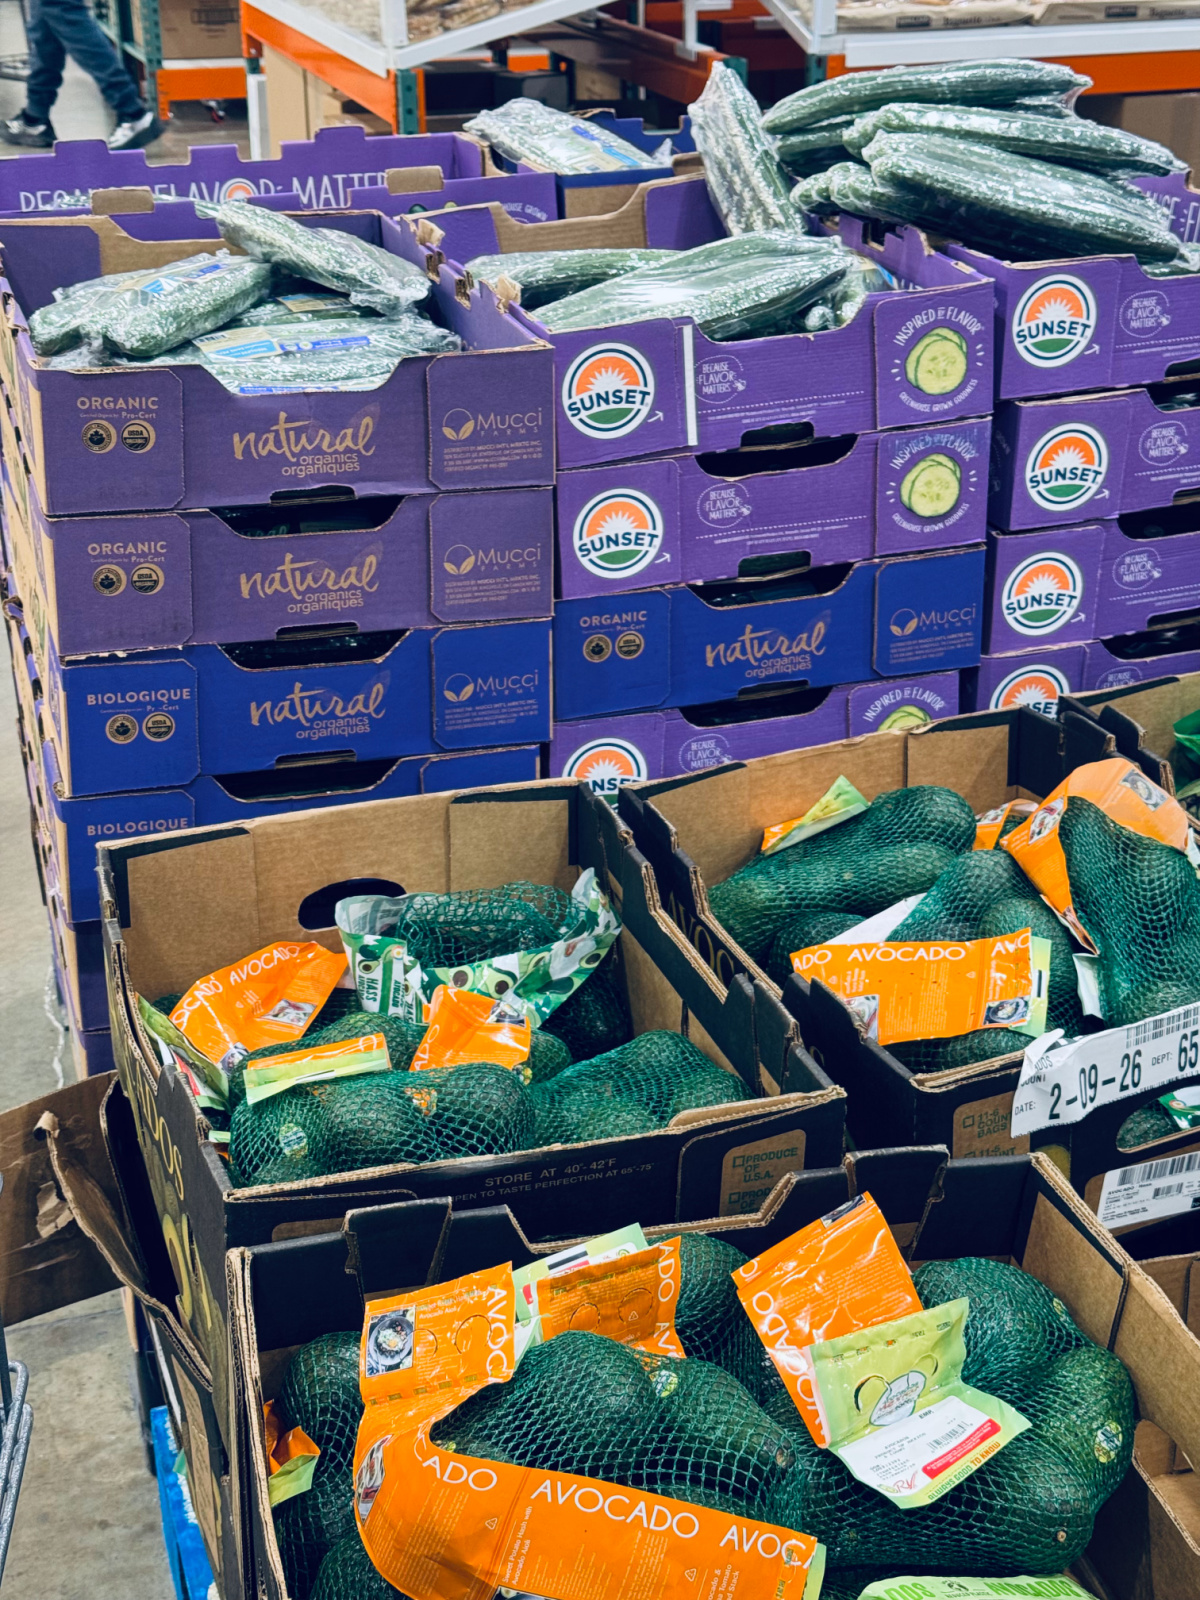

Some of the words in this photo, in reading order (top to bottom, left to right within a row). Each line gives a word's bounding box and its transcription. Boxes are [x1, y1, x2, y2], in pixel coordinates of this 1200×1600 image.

[1132, 297, 1157, 307] BECAUSE
[1127, 306, 1160, 319] FLAVOR
[893, 308, 936, 346] INSPIRED
[946, 306, 981, 335] FLAVOR
[1130, 317, 1157, 329] MATTERS
[1016, 320, 1091, 344] SUNSET
[702, 361, 729, 373] BECAUSE
[699, 371, 734, 385] FLAVOR
[702, 383, 731, 394] MATTERS
[899, 391, 931, 412] GREENHOUSE
[932, 401, 953, 412] GROWN
[953, 378, 978, 404] GOODNESS
[77, 397, 158, 409] ORGANIC
[567, 388, 651, 418] SUNSET
[122, 411, 156, 419] Pro-Cert
[233, 411, 376, 462] natural
[481, 427, 538, 437] FARMS
[1151, 427, 1176, 437] BECAUSE
[1147, 436, 1178, 449] FLAVOR
[300, 453, 358, 464] organics
[889, 435, 931, 470] INSPIRED
[941, 434, 976, 462] FLAVOR
[1149, 447, 1174, 457] MATTERS
[282, 462, 360, 477] organiques
[1029, 467, 1102, 489] SUNSET
[709, 488, 735, 500] BECAUSE
[705, 498, 740, 512] FLAVOR
[709, 509, 737, 520] MATTERS
[892, 512, 921, 533] GREENHOUSE
[923, 524, 943, 533] GROWN
[87, 541, 168, 555] ORGANIC
[578, 531, 659, 558] SUNSET
[131, 555, 165, 563] Pro-Cert
[481, 562, 537, 571] FARMS
[1124, 554, 1148, 564] BECAUSE
[1121, 562, 1152, 574] FLAVOR
[240, 553, 379, 599] natural
[1123, 571, 1148, 582] MATTERS
[305, 590, 361, 602] organics
[287, 599, 364, 614] organiques
[1005, 592, 1077, 616] SUNSET
[580, 611, 647, 627] ORGANIC
[705, 624, 826, 667] natural
[761, 654, 810, 667] organics
[745, 661, 811, 678] organiques
[87, 688, 191, 705] BIOLOGIQUE
[251, 682, 386, 727] natural
[862, 689, 902, 722] INSPIRED
[912, 687, 945, 711] FLAVOR
[313, 717, 369, 729] organics
[296, 724, 370, 740] organiques
[691, 740, 716, 751] BECAUSE
[687, 748, 721, 761] FLAVOR
[690, 758, 718, 769] MATTERS
[87, 818, 188, 836] BIOLOGIQUE
[847, 947, 966, 962] AVOCADO
[230, 945, 299, 986] AVOCADO
[365, 977, 379, 1002] HASS
[1151, 1052, 1172, 1066] DEPT:
[1178, 1029, 1199, 1072] 65
[1015, 1101, 1036, 1116] DATE:
[978, 1122, 1007, 1138] BAGS
[745, 1147, 798, 1164] PRODUCE
[744, 1163, 759, 1173] OF
[480, 1190, 495, 1198] TO
[499, 1184, 531, 1195] TASTE
[535, 1172, 603, 1189] PERFECTION
[606, 1169, 618, 1177] AT
[485, 1172, 533, 1187] STORE
[540, 1168, 557, 1178] AT
[743, 1170, 774, 1182] U.S.A.
[928, 1478, 956, 1500] ALWAYS
[953, 1465, 973, 1481] GOOD
[970, 1456, 982, 1467] TO
[981, 1441, 1001, 1460] KNOW
[531, 1480, 699, 1538] AVOCADO
[517, 1521, 527, 1538] Hash
[524, 1506, 533, 1520] with
[512, 1555, 526, 1585] Avocado
[719, 1564, 732, 1591] Tomato
[729, 1571, 740, 1592] Stack
